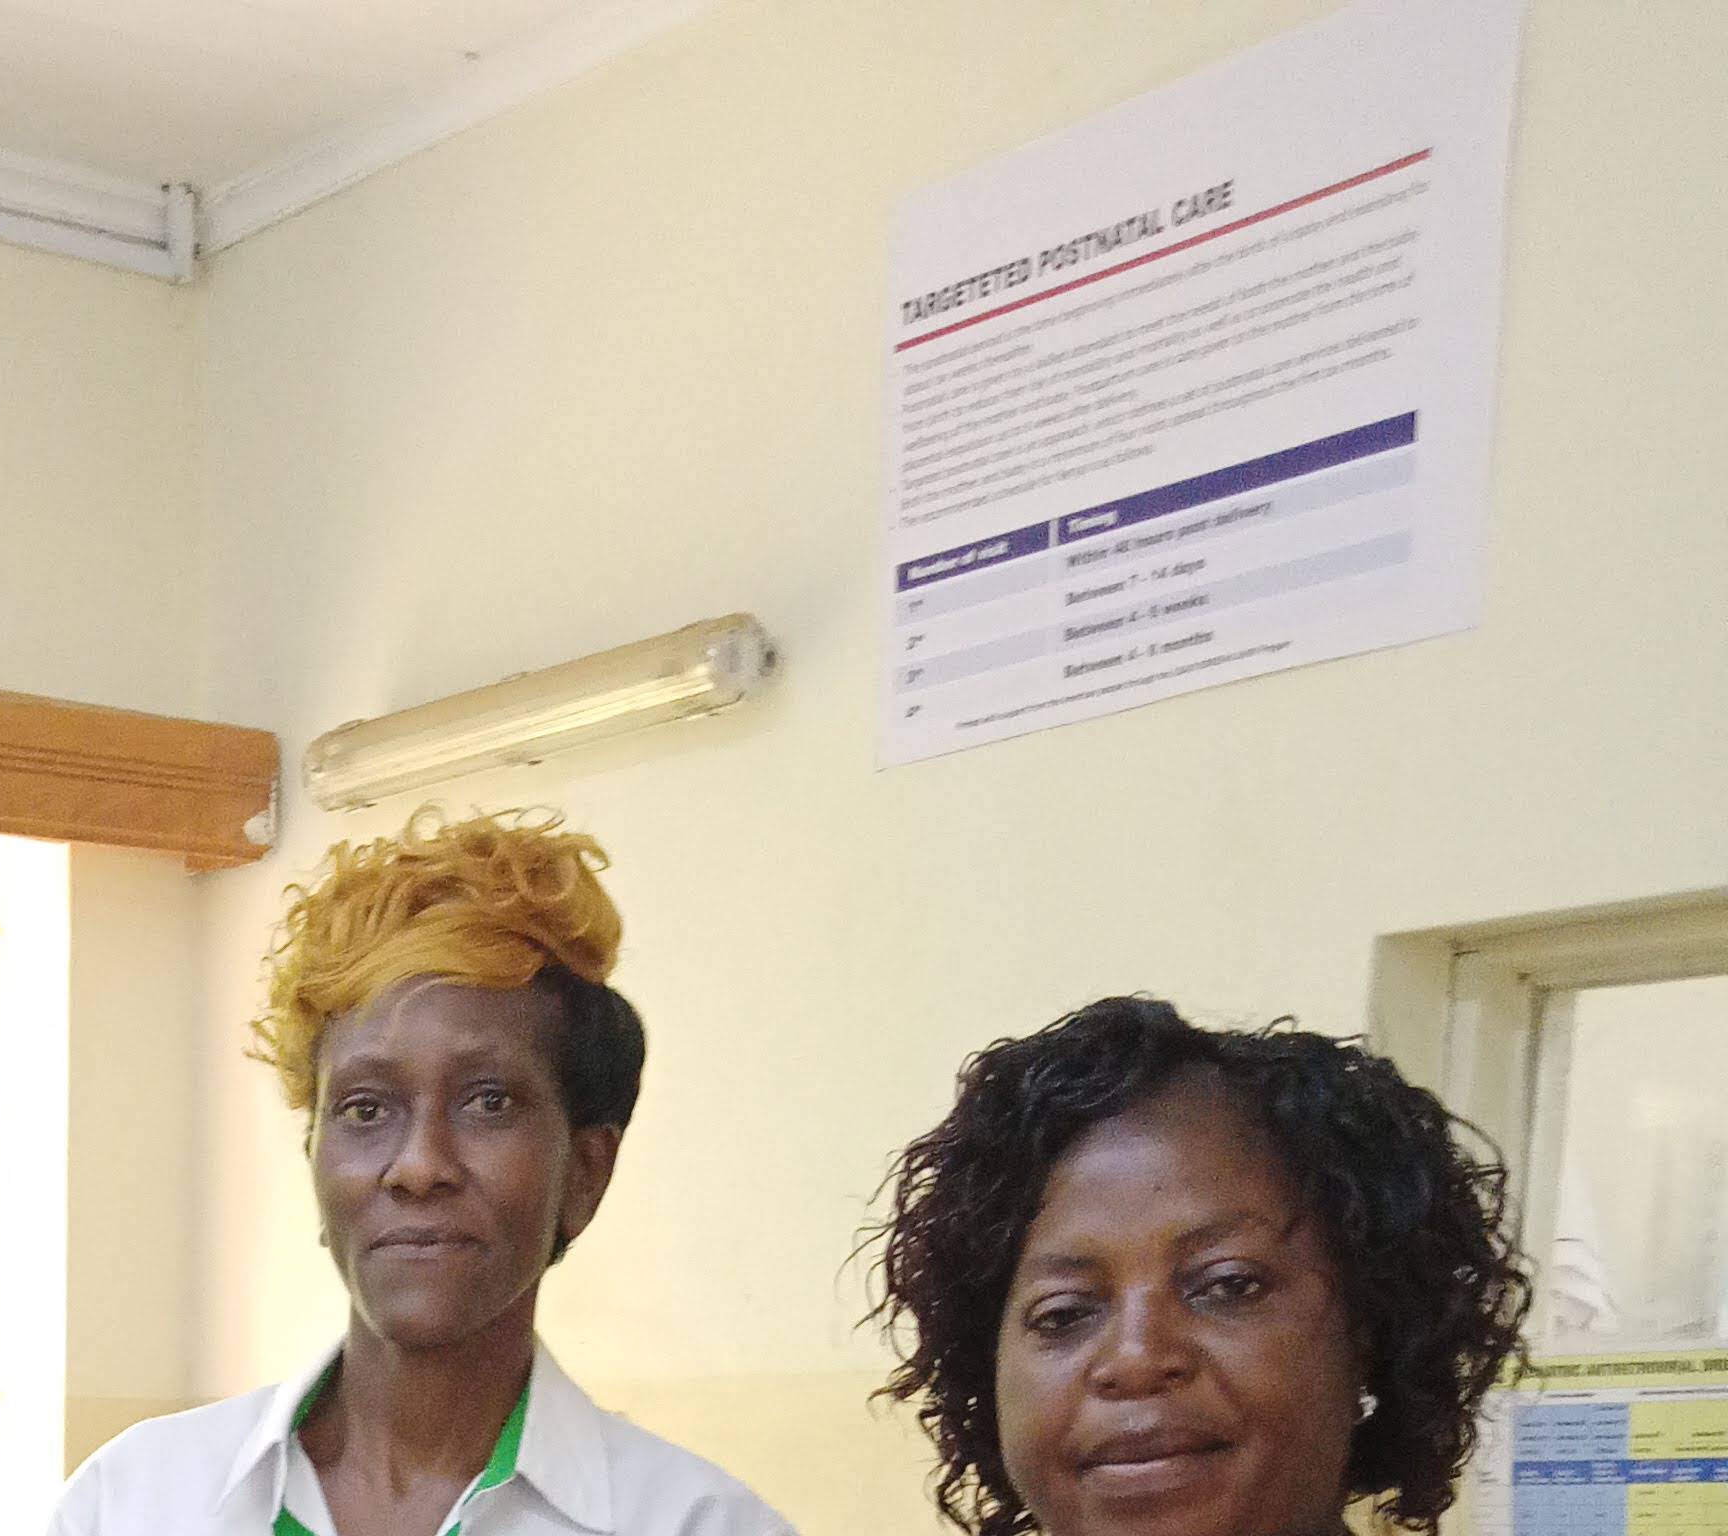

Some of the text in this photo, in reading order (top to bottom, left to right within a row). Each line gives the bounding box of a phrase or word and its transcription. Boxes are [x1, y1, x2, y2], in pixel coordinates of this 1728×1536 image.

[900, 178, 1235, 326] TARGETETED POSTNATAL CARE
